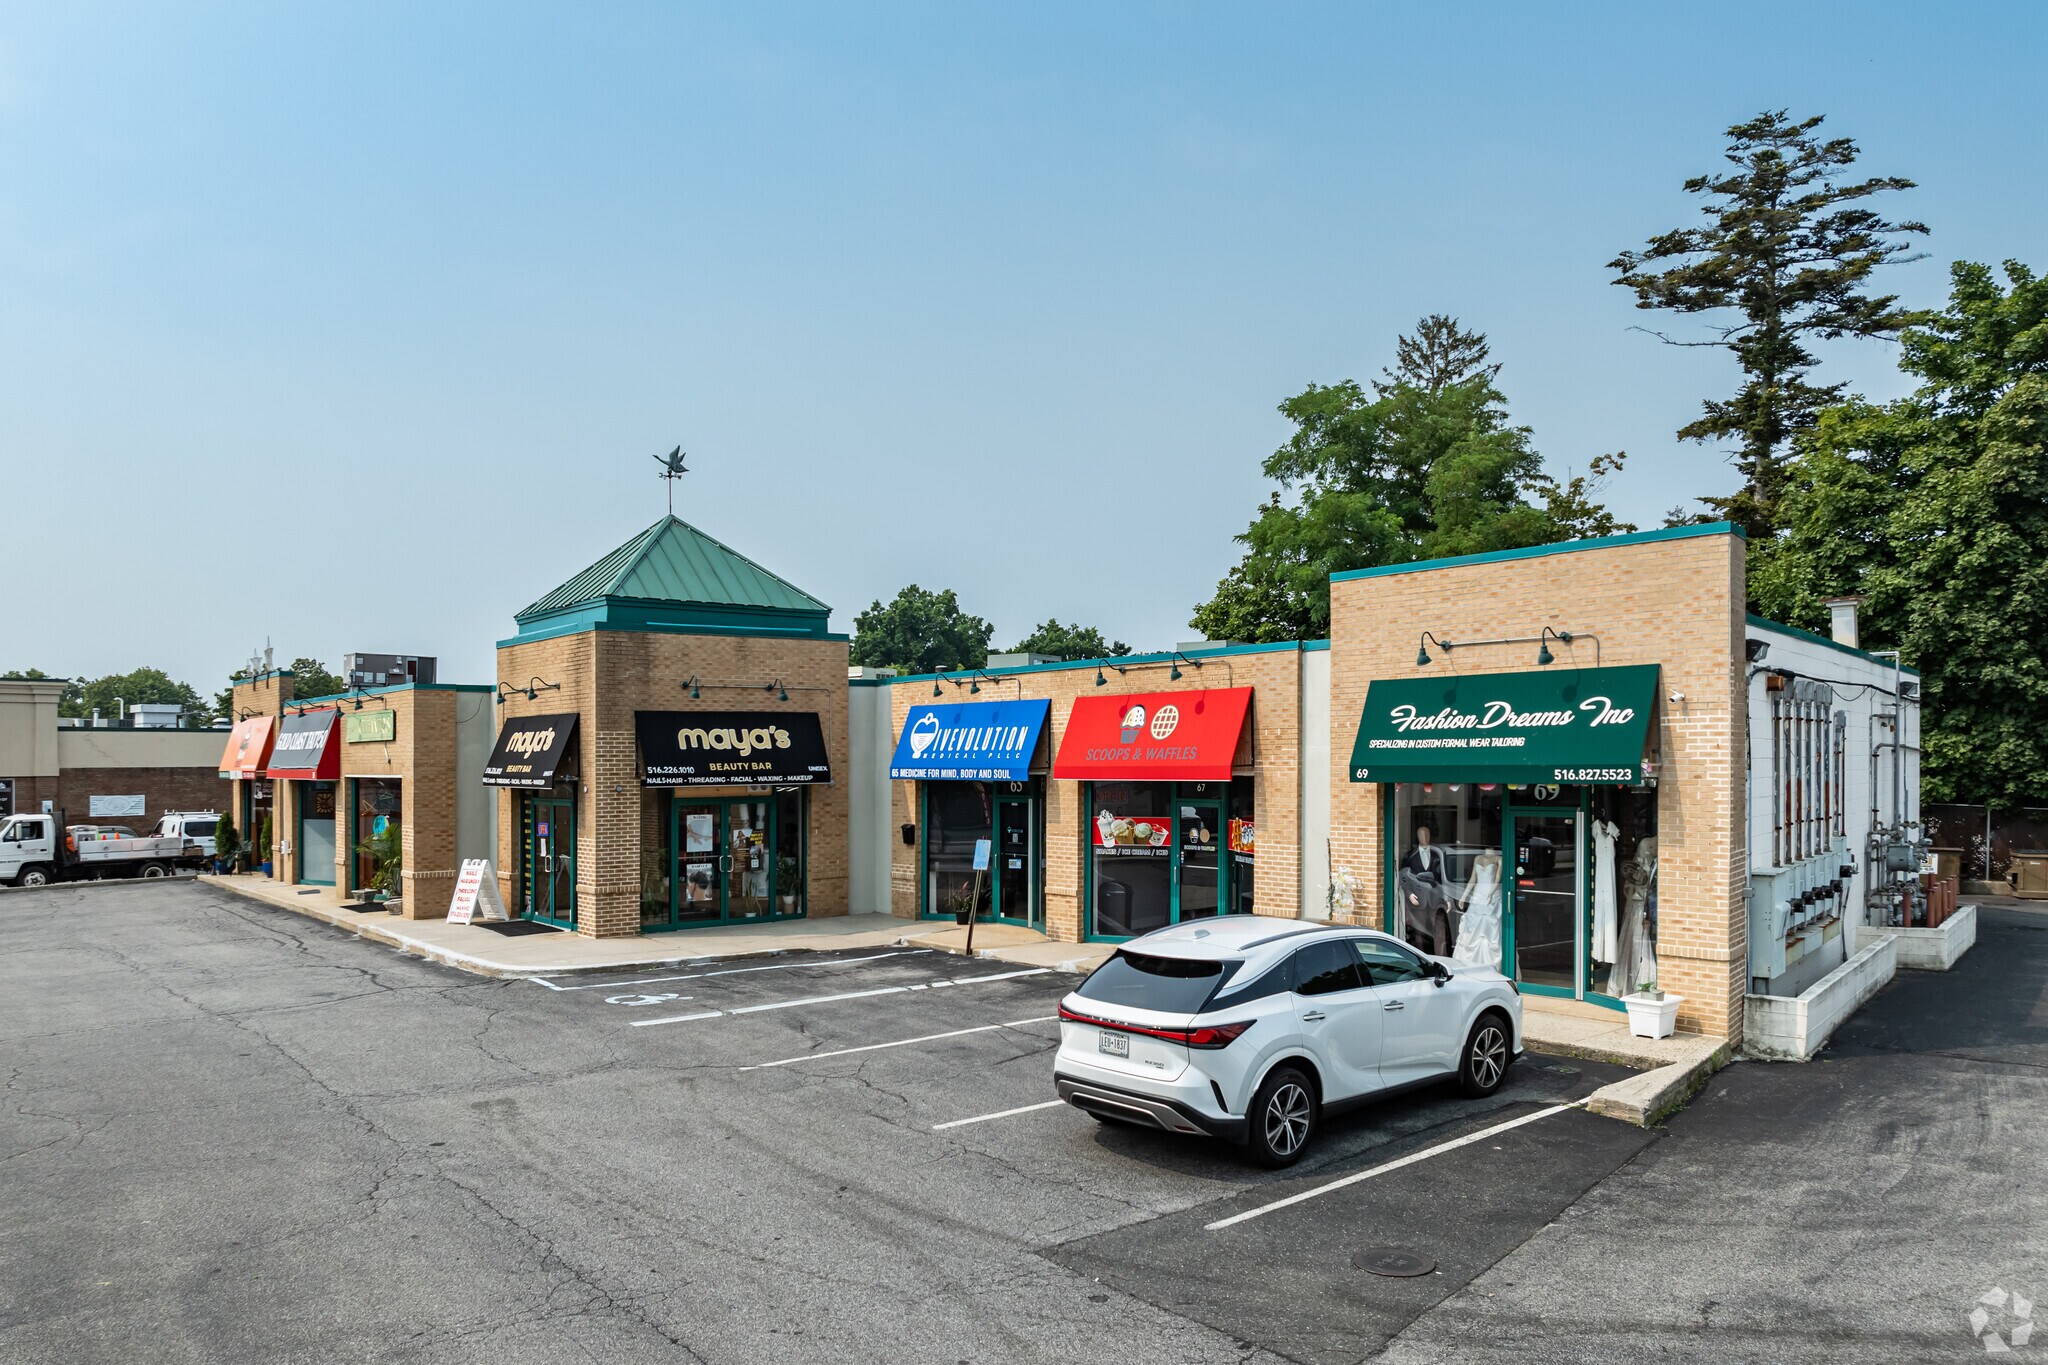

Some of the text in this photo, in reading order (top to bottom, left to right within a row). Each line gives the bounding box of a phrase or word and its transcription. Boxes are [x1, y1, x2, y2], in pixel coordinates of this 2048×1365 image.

[1390, 696, 1635, 732] Fashion Dreams Inc
[677, 725, 791, 757] maya's
[1369, 737, 1526, 748] SPECIALIZING IN CUSTOM FORMAL WEAR TAILORING
[1086, 746, 1198, 760] SCOOPS & WAFFLES
[647, 766, 695, 774] 516.226.1010
[709, 762, 772, 771] BEAUTY BAR
[891, 768, 1011, 779] 65 MEDICINE FOR MIND, BODY AND SOUL
[1356, 769, 1368, 779] 69
[1554, 768, 1632, 781] 516.827.5523
[1196, 783, 1206, 792] 67
[1534, 784, 1560, 800] 69
